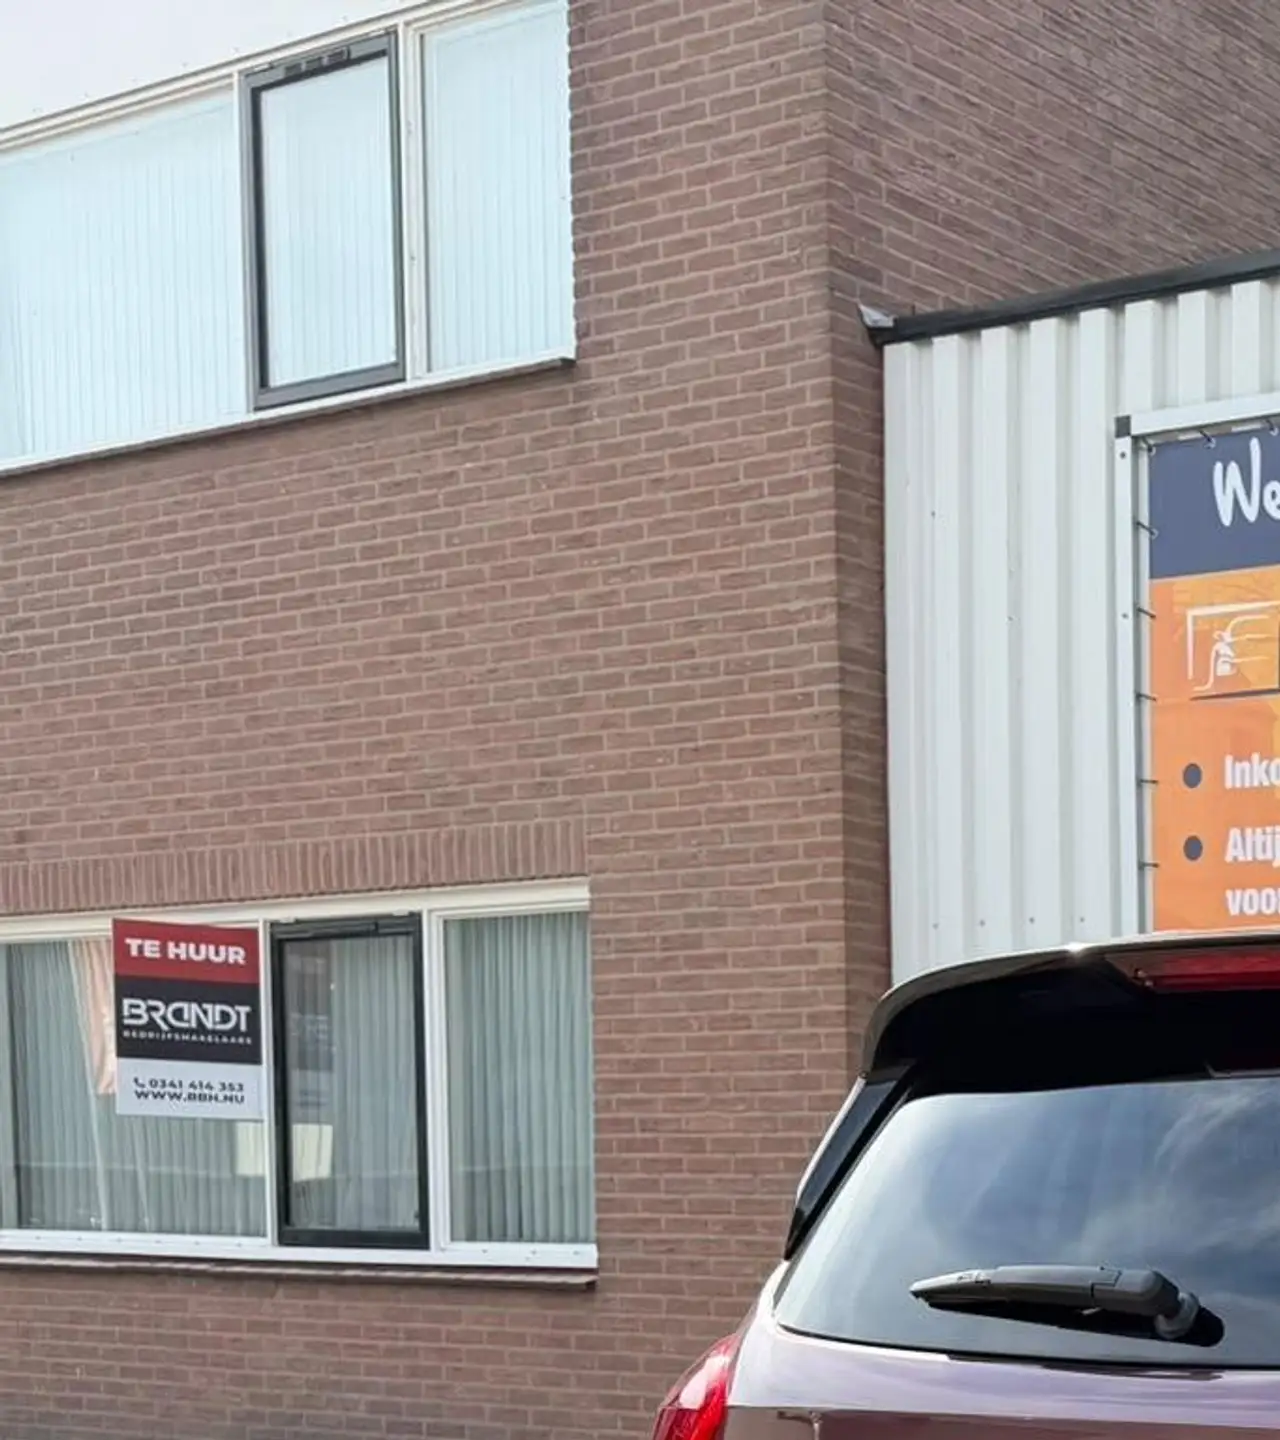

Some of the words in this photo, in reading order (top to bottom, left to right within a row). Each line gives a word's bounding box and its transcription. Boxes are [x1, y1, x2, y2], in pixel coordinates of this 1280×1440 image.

[125, 938, 161, 958] TE
[167, 942, 246, 965] HUUR
[122, 998, 251, 1032] BRANDT
